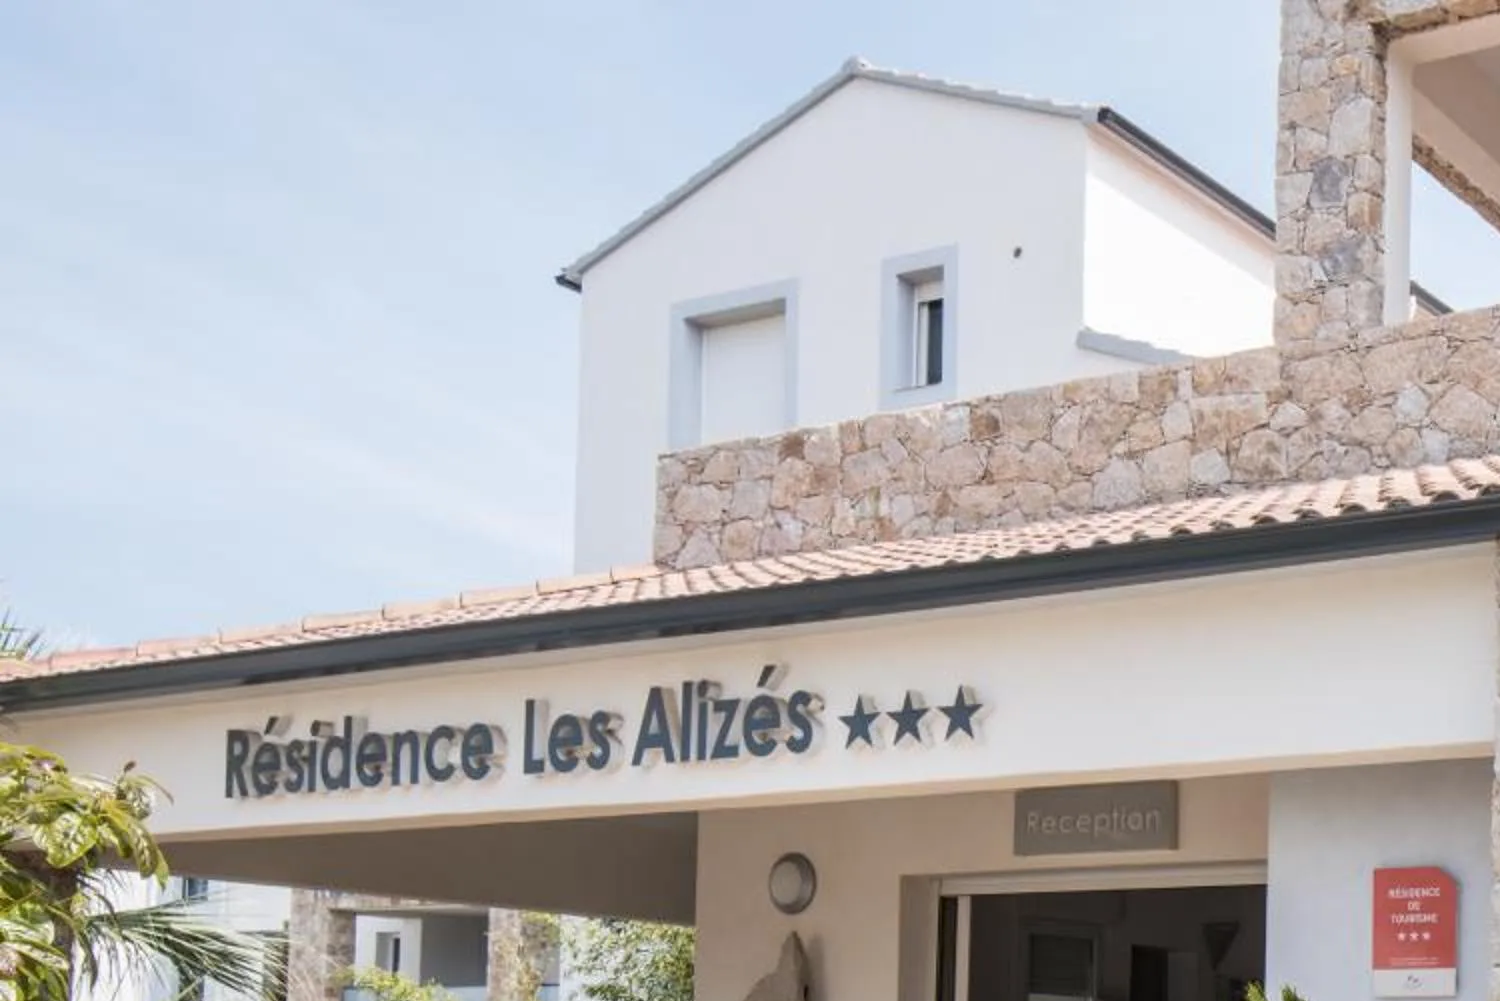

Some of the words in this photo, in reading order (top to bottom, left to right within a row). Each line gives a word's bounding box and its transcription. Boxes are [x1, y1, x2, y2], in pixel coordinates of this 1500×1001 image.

[226, 715, 494, 798] Résidence
[523, 698, 613, 774] Les
[631, 664, 815, 766] Alizés
[1026, 807, 1161, 838] Reception
[1407, 901, 1420, 911] DE
